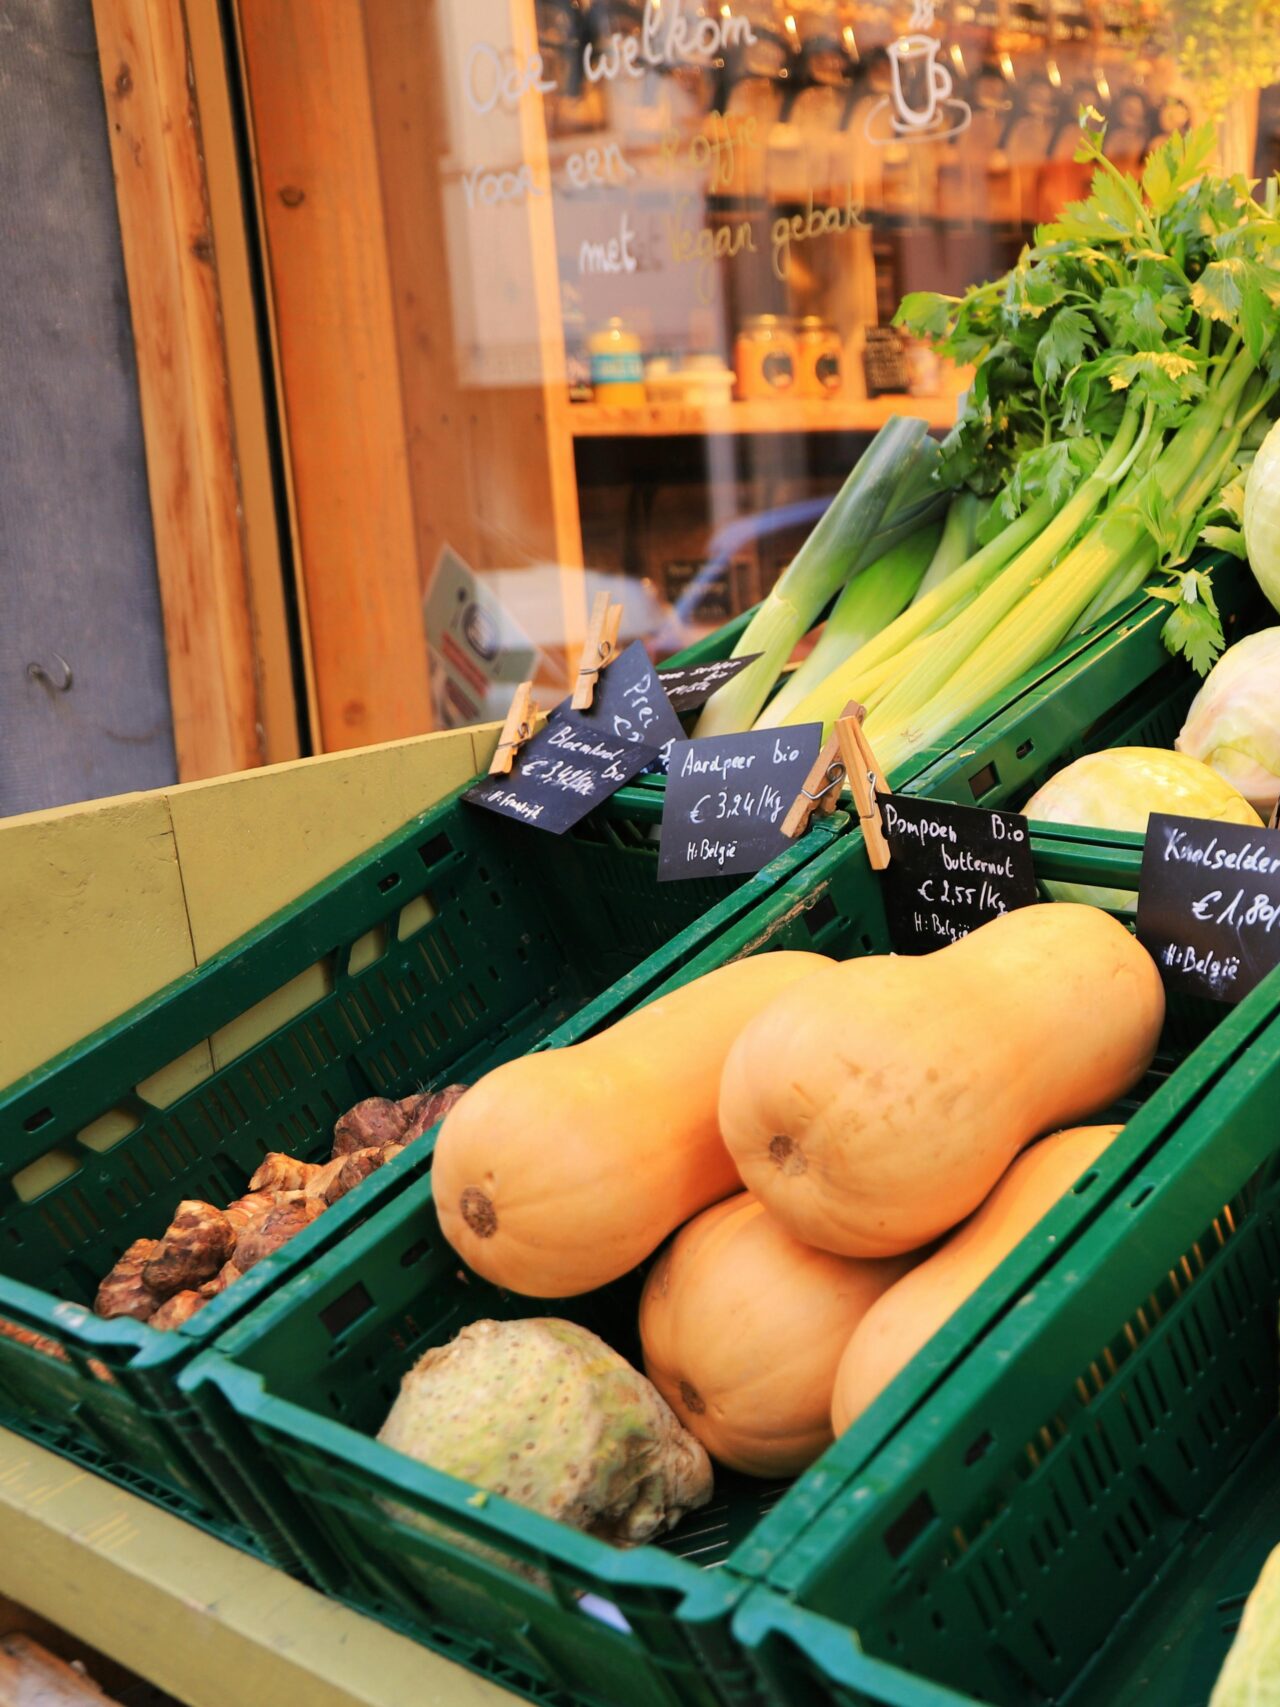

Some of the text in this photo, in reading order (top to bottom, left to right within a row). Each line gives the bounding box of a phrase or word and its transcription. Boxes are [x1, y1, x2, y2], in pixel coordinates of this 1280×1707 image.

[583, 0, 758, 83] welkom
[566, 143, 637, 190] een
[579, 211, 638, 274] met
[771, 181, 873, 282] gebak
[623, 673, 660, 729] Prei
[521, 760, 549, 777] €
[681, 738, 800, 781] Aardpeer bio
[689, 794, 712, 824] €
[885, 803, 1025, 847] Pompoen Bio
[941, 843, 1015, 878] butternut
[917, 879, 934, 902] €
[914, 911, 929, 933] H:
